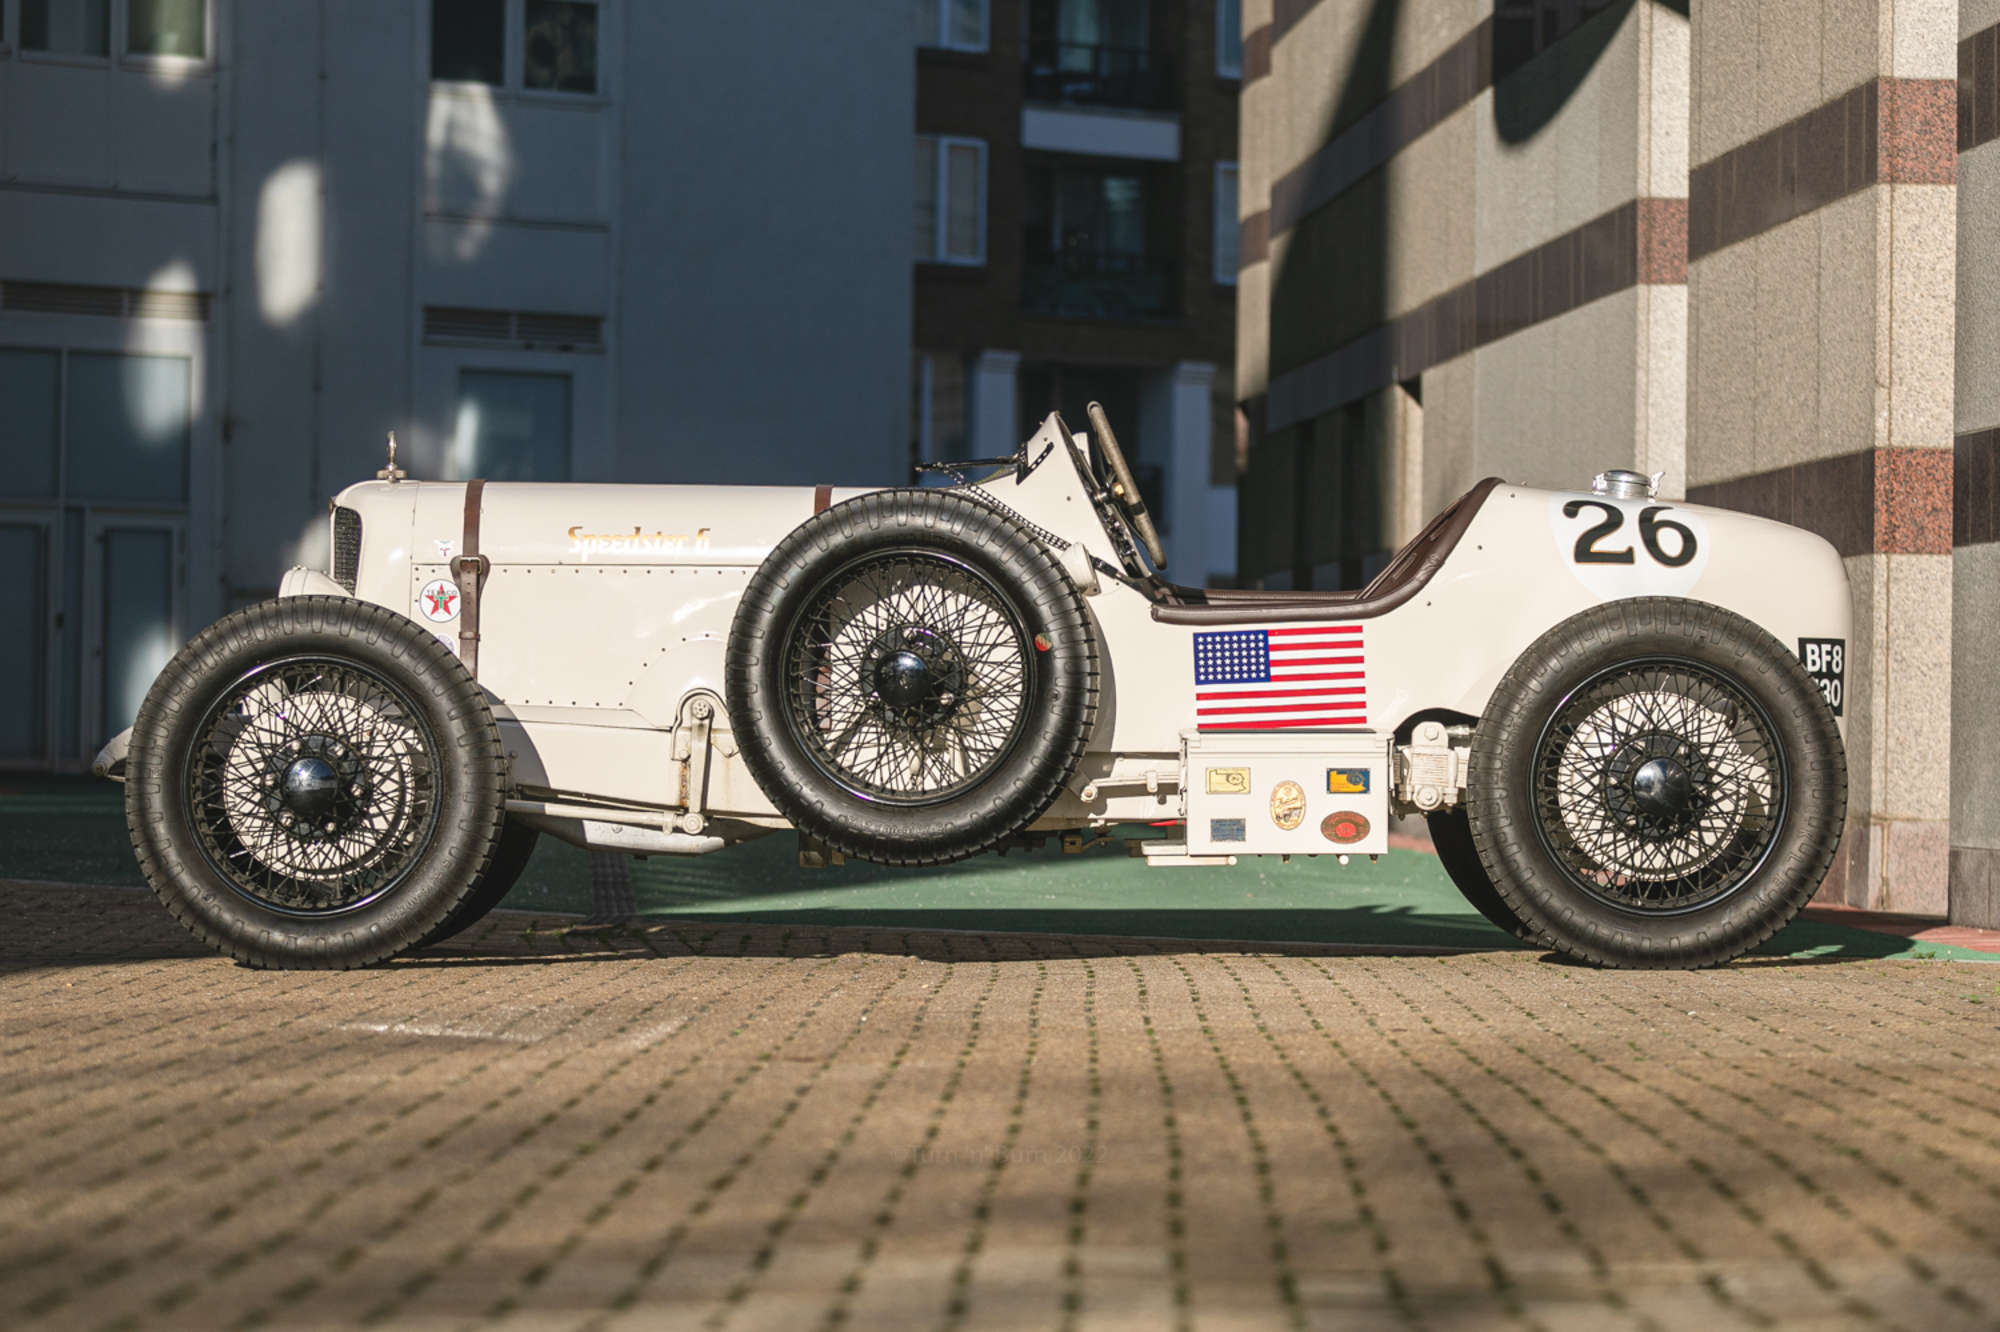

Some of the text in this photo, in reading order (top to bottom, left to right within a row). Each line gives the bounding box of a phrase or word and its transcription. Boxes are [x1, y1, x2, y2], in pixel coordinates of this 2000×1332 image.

[1562, 499, 1697, 568] 26
[1805, 643, 1843, 673] BF8
[1815, 678, 1841, 707] 30
